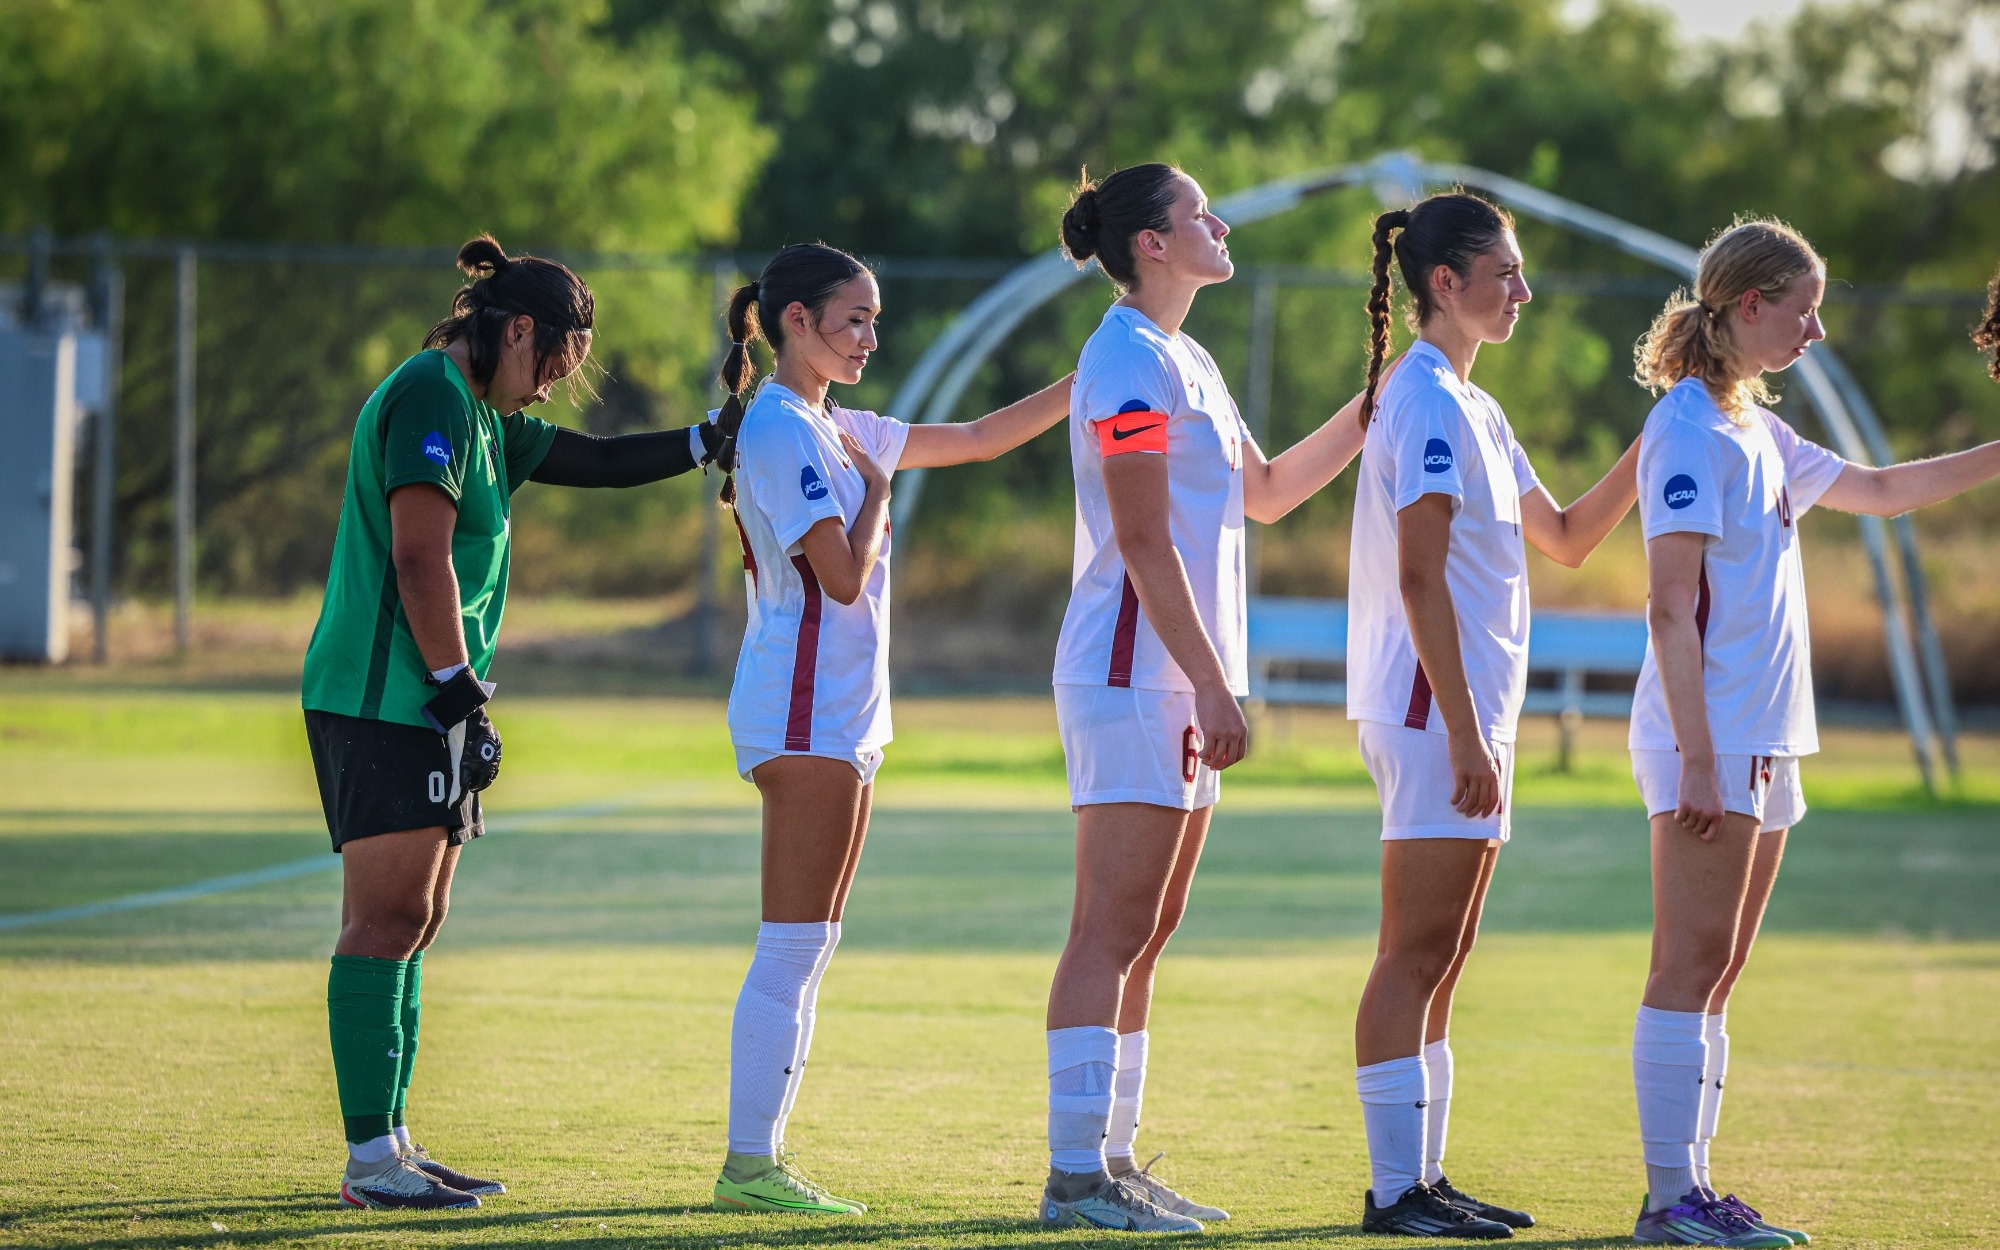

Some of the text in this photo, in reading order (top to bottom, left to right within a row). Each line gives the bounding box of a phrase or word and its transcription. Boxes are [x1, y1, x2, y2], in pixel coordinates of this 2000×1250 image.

[1425, 455, 1452, 466] NCAA
[1667, 489, 1696, 504] NCAA
[1182, 725, 1198, 783] 6
[428, 770, 446, 803] 0
